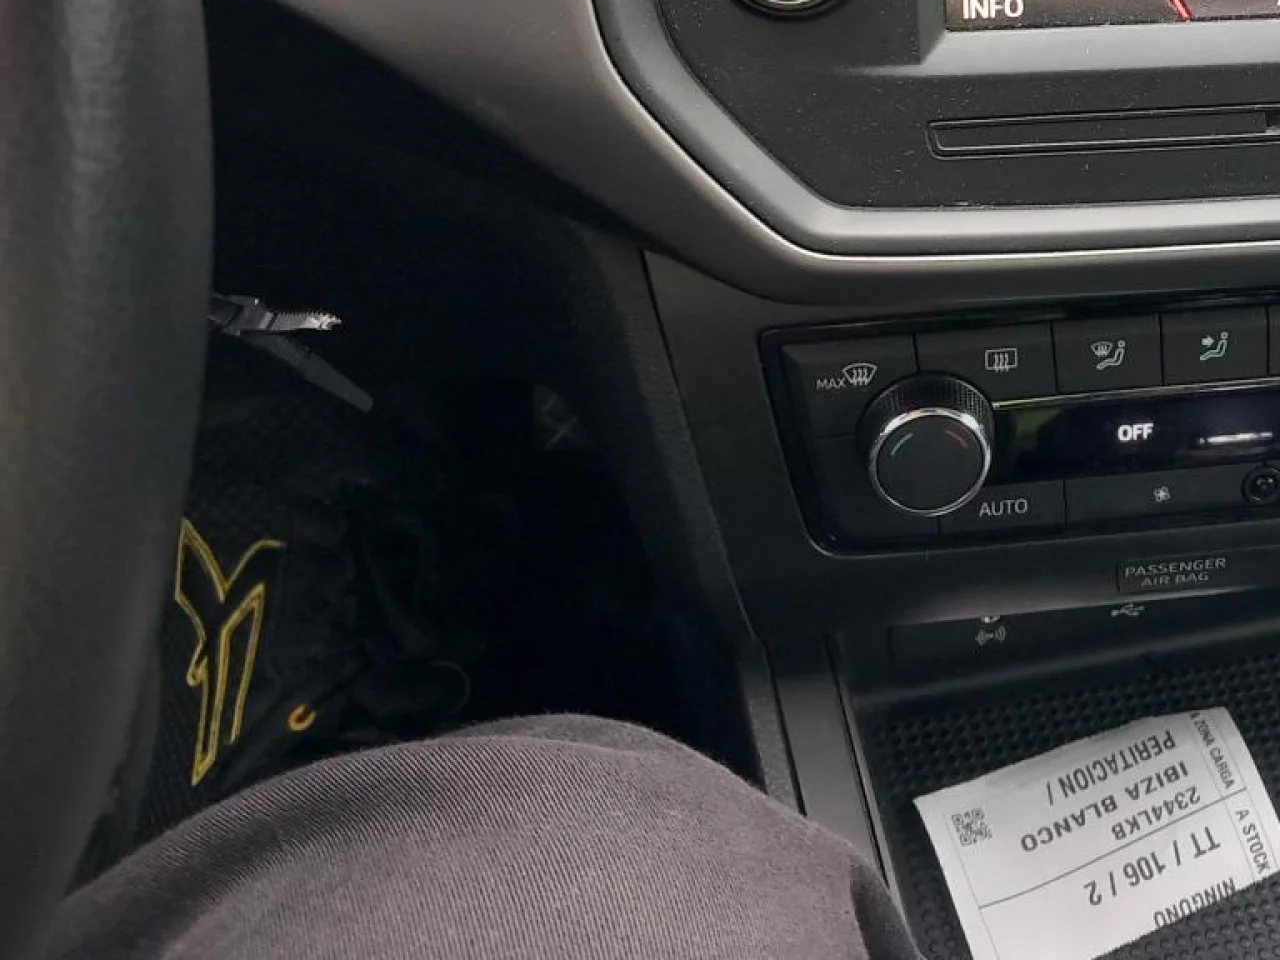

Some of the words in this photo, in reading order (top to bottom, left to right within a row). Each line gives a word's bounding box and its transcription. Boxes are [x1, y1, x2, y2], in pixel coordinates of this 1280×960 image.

[815, 375, 847, 391] MAX
[1117, 422, 1154, 442] OFF
[979, 498, 1028, 517] AUTO
[1124, 557, 1226, 578] PASSENGER
[1141, 574, 1171, 588] AIR
[1174, 571, 1209, 585] BAG
[1057, 729, 1177, 798] PERITACION
[1124, 760, 1189, 801] IBIZA
[1209, 747, 1235, 789] CARGA
[1020, 794, 1118, 852] BLANCO
[1111, 786, 1201, 840] 2344LKB
[1189, 826, 1221, 859] TT
[1242, 824, 1271, 874] STOCK
[1122, 851, 1166, 887] 106
[1082, 880, 1102, 905] 2
